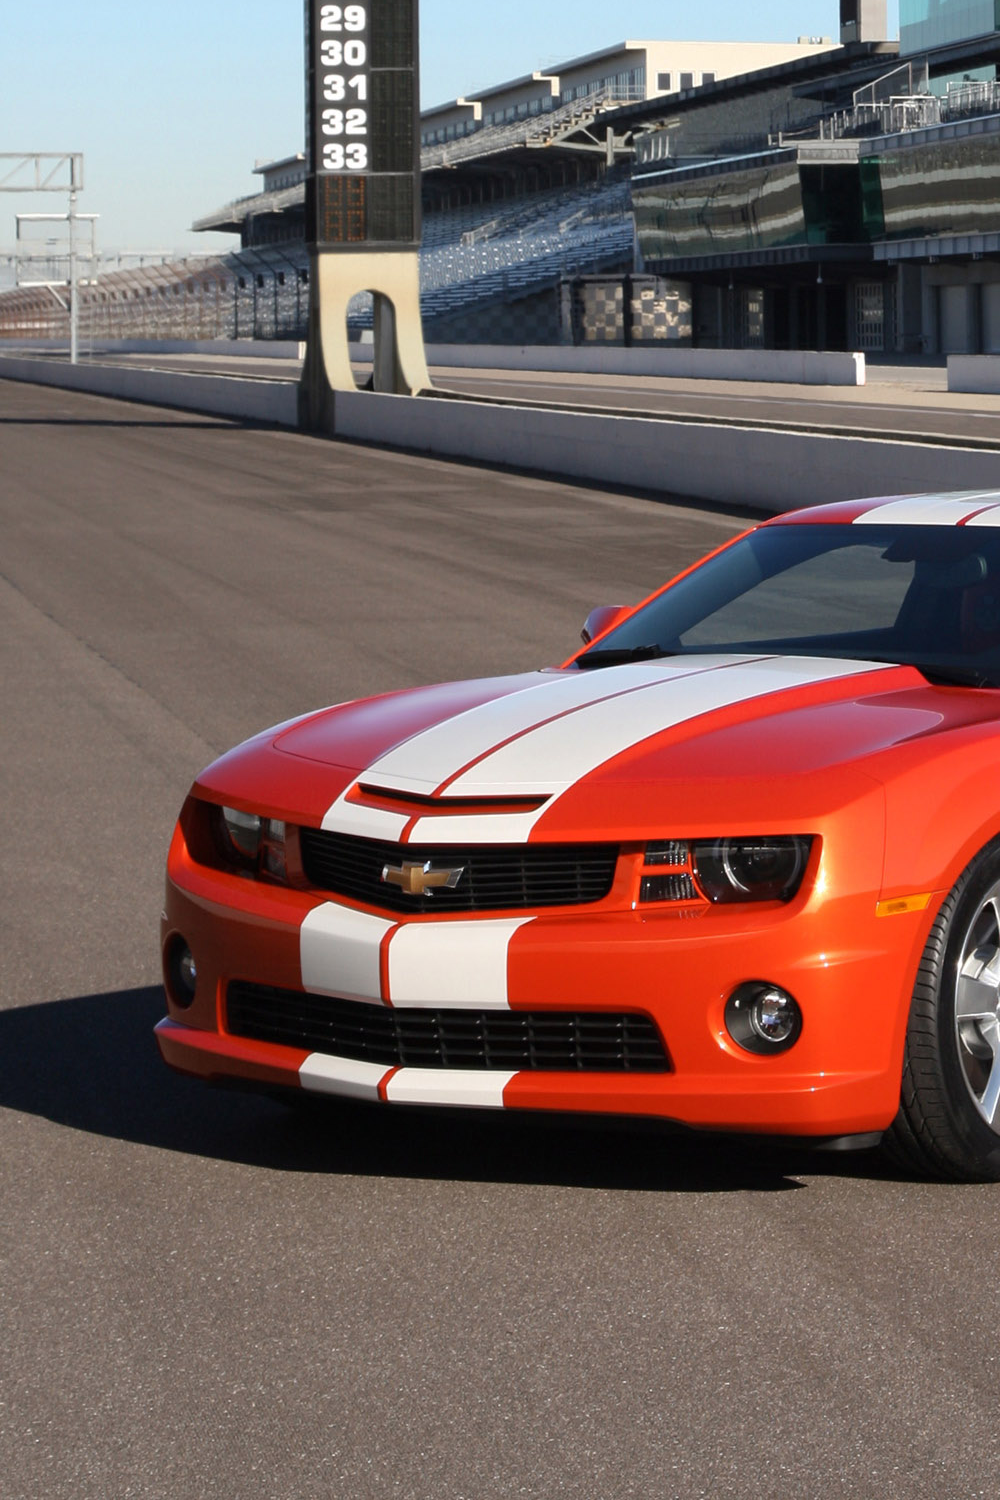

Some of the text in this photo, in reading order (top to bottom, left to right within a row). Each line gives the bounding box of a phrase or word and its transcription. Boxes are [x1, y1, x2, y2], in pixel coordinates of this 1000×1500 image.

[320, 5, 367, 31] 29
[320, 40, 367, 66] 30
[323, 74, 367, 101] 31
[321, 109, 368, 135] 32
[322, 143, 368, 170] 33
